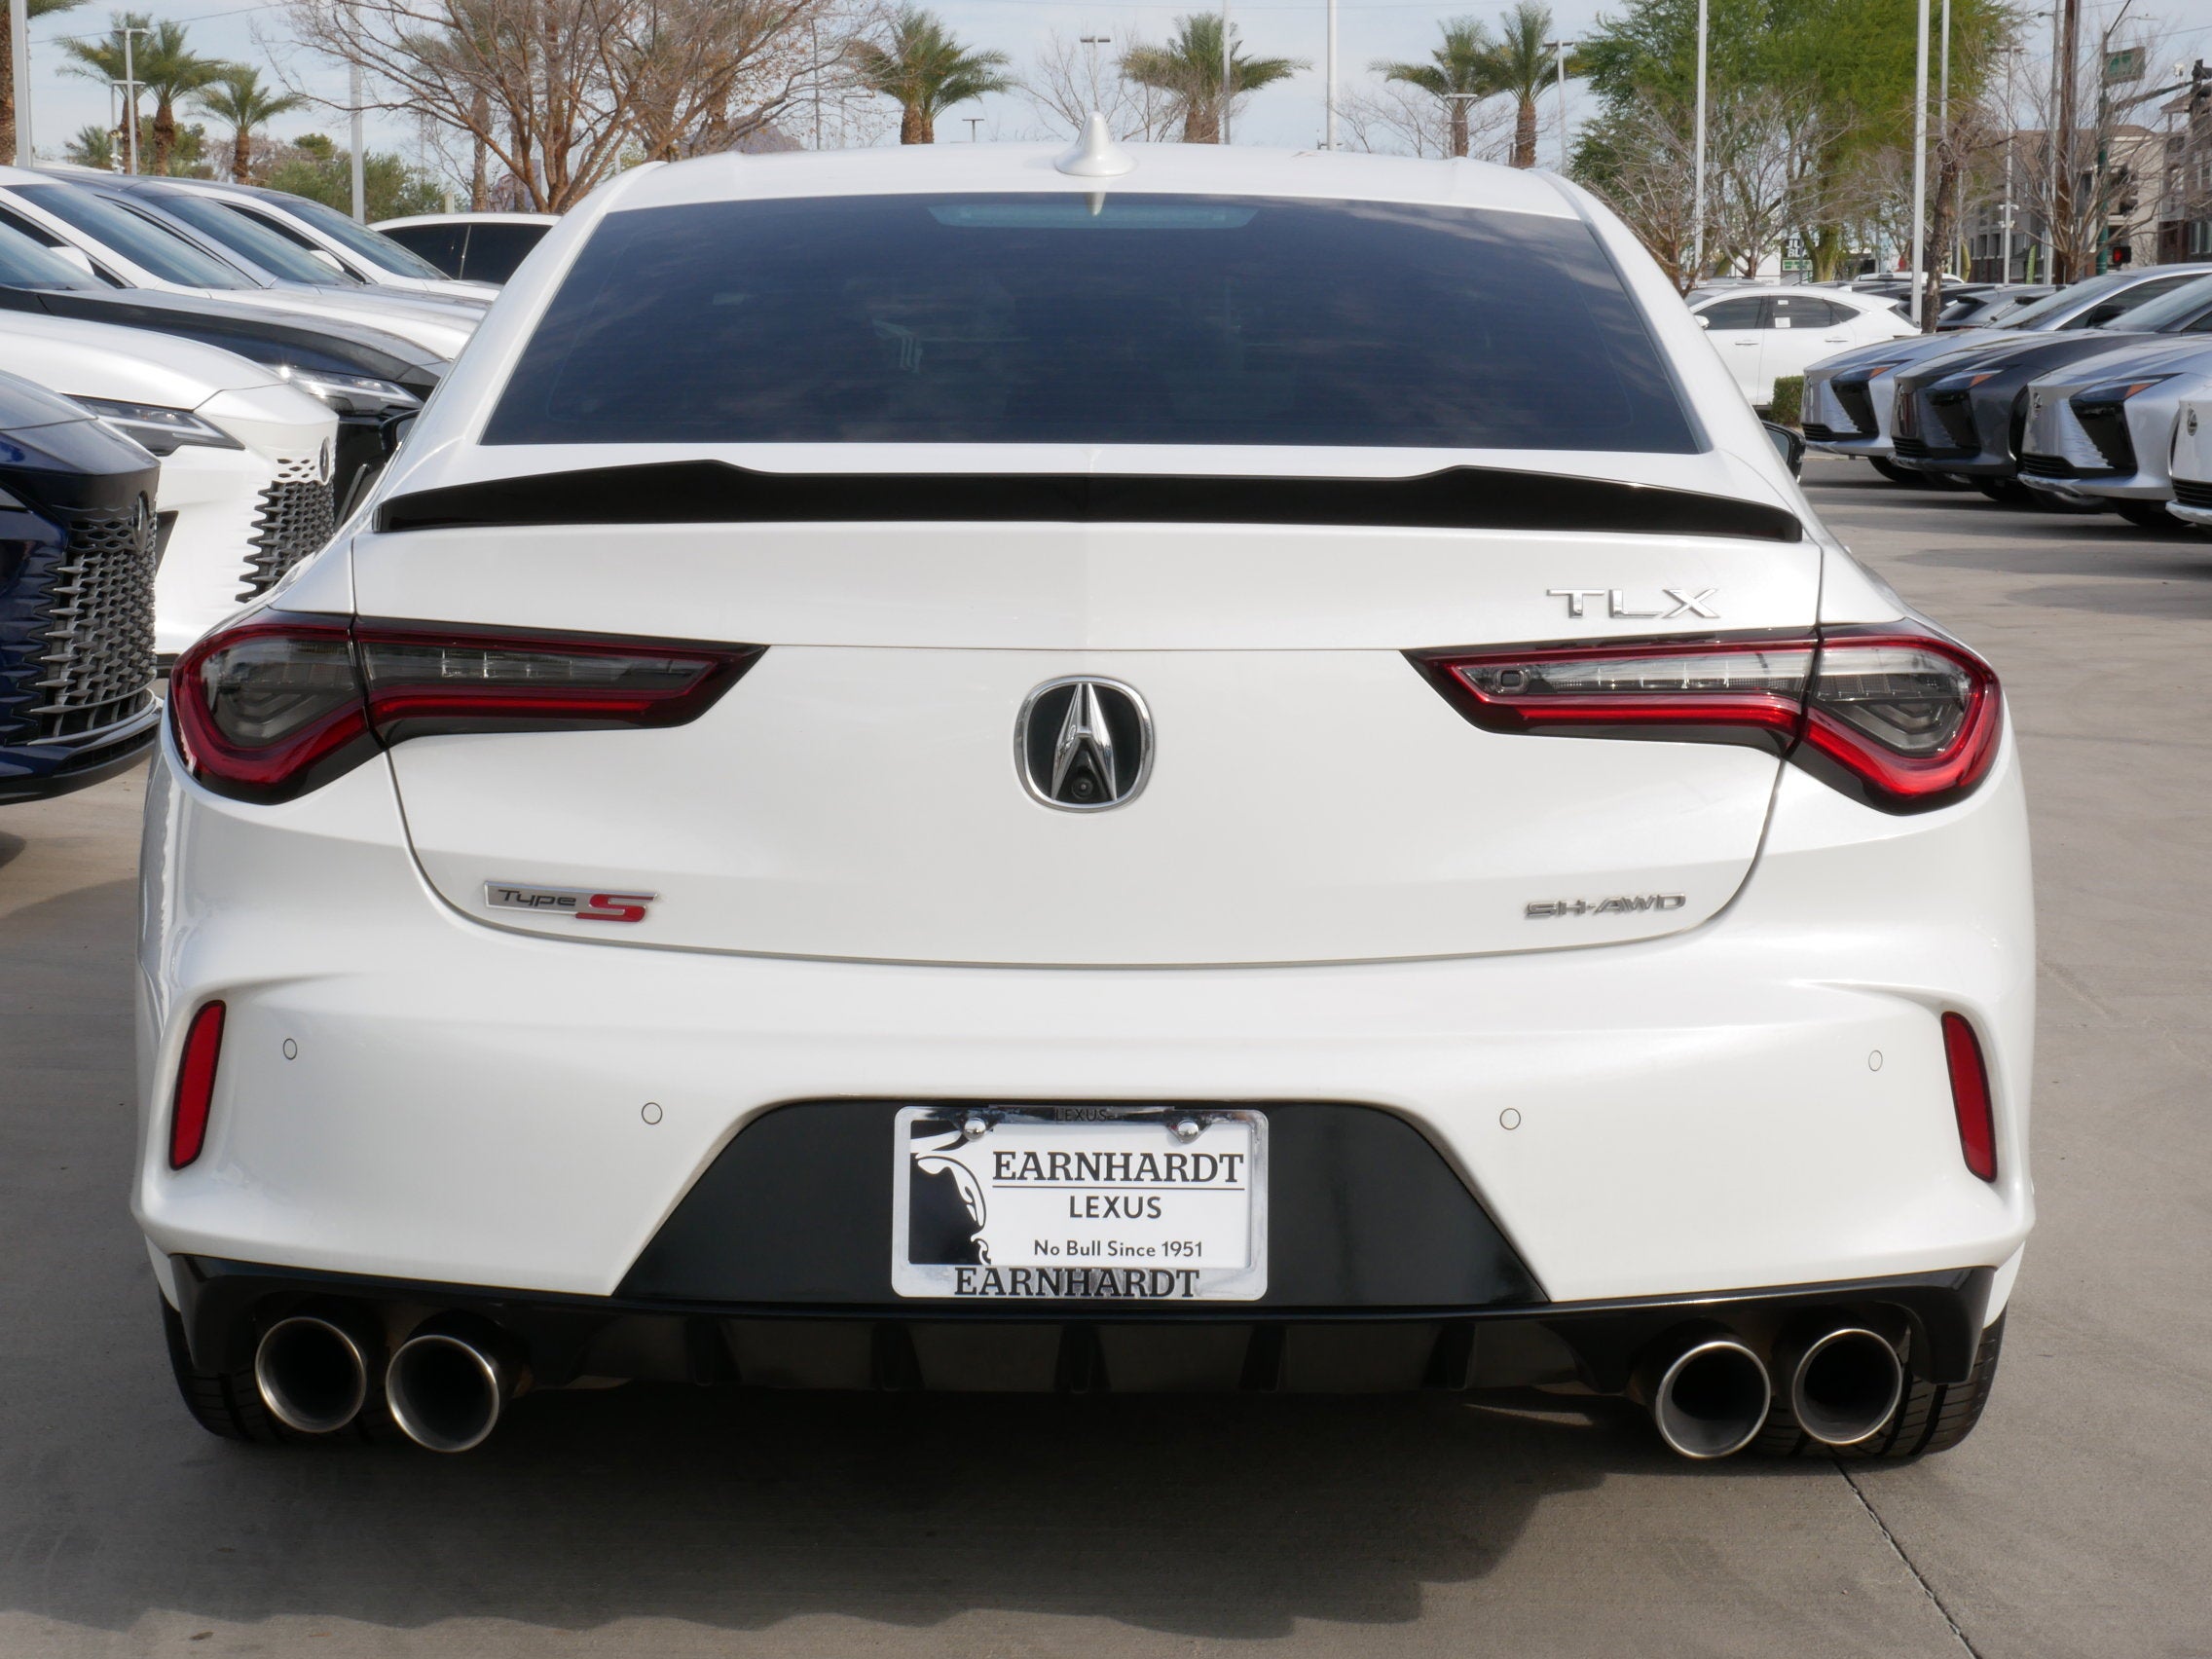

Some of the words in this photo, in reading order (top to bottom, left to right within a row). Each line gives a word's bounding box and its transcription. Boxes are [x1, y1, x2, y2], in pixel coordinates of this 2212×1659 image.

[1546, 589, 1720, 618] TLX
[498, 889, 576, 907] Type
[575, 893, 656, 922] S
[1526, 893, 1686, 919] SH-AWD
[1054, 1108, 1107, 1122] LEXUS
[992, 1151, 1244, 1183] EARNHARDT
[1070, 1196, 1161, 1219] LEXUS
[1034, 1239, 1060, 1256] No
[1066, 1240, 1101, 1256] Bull
[1107, 1240, 1157, 1257] Since
[1161, 1241, 1202, 1257] 1951
[954, 1267, 1200, 1298] EARNHARDT
